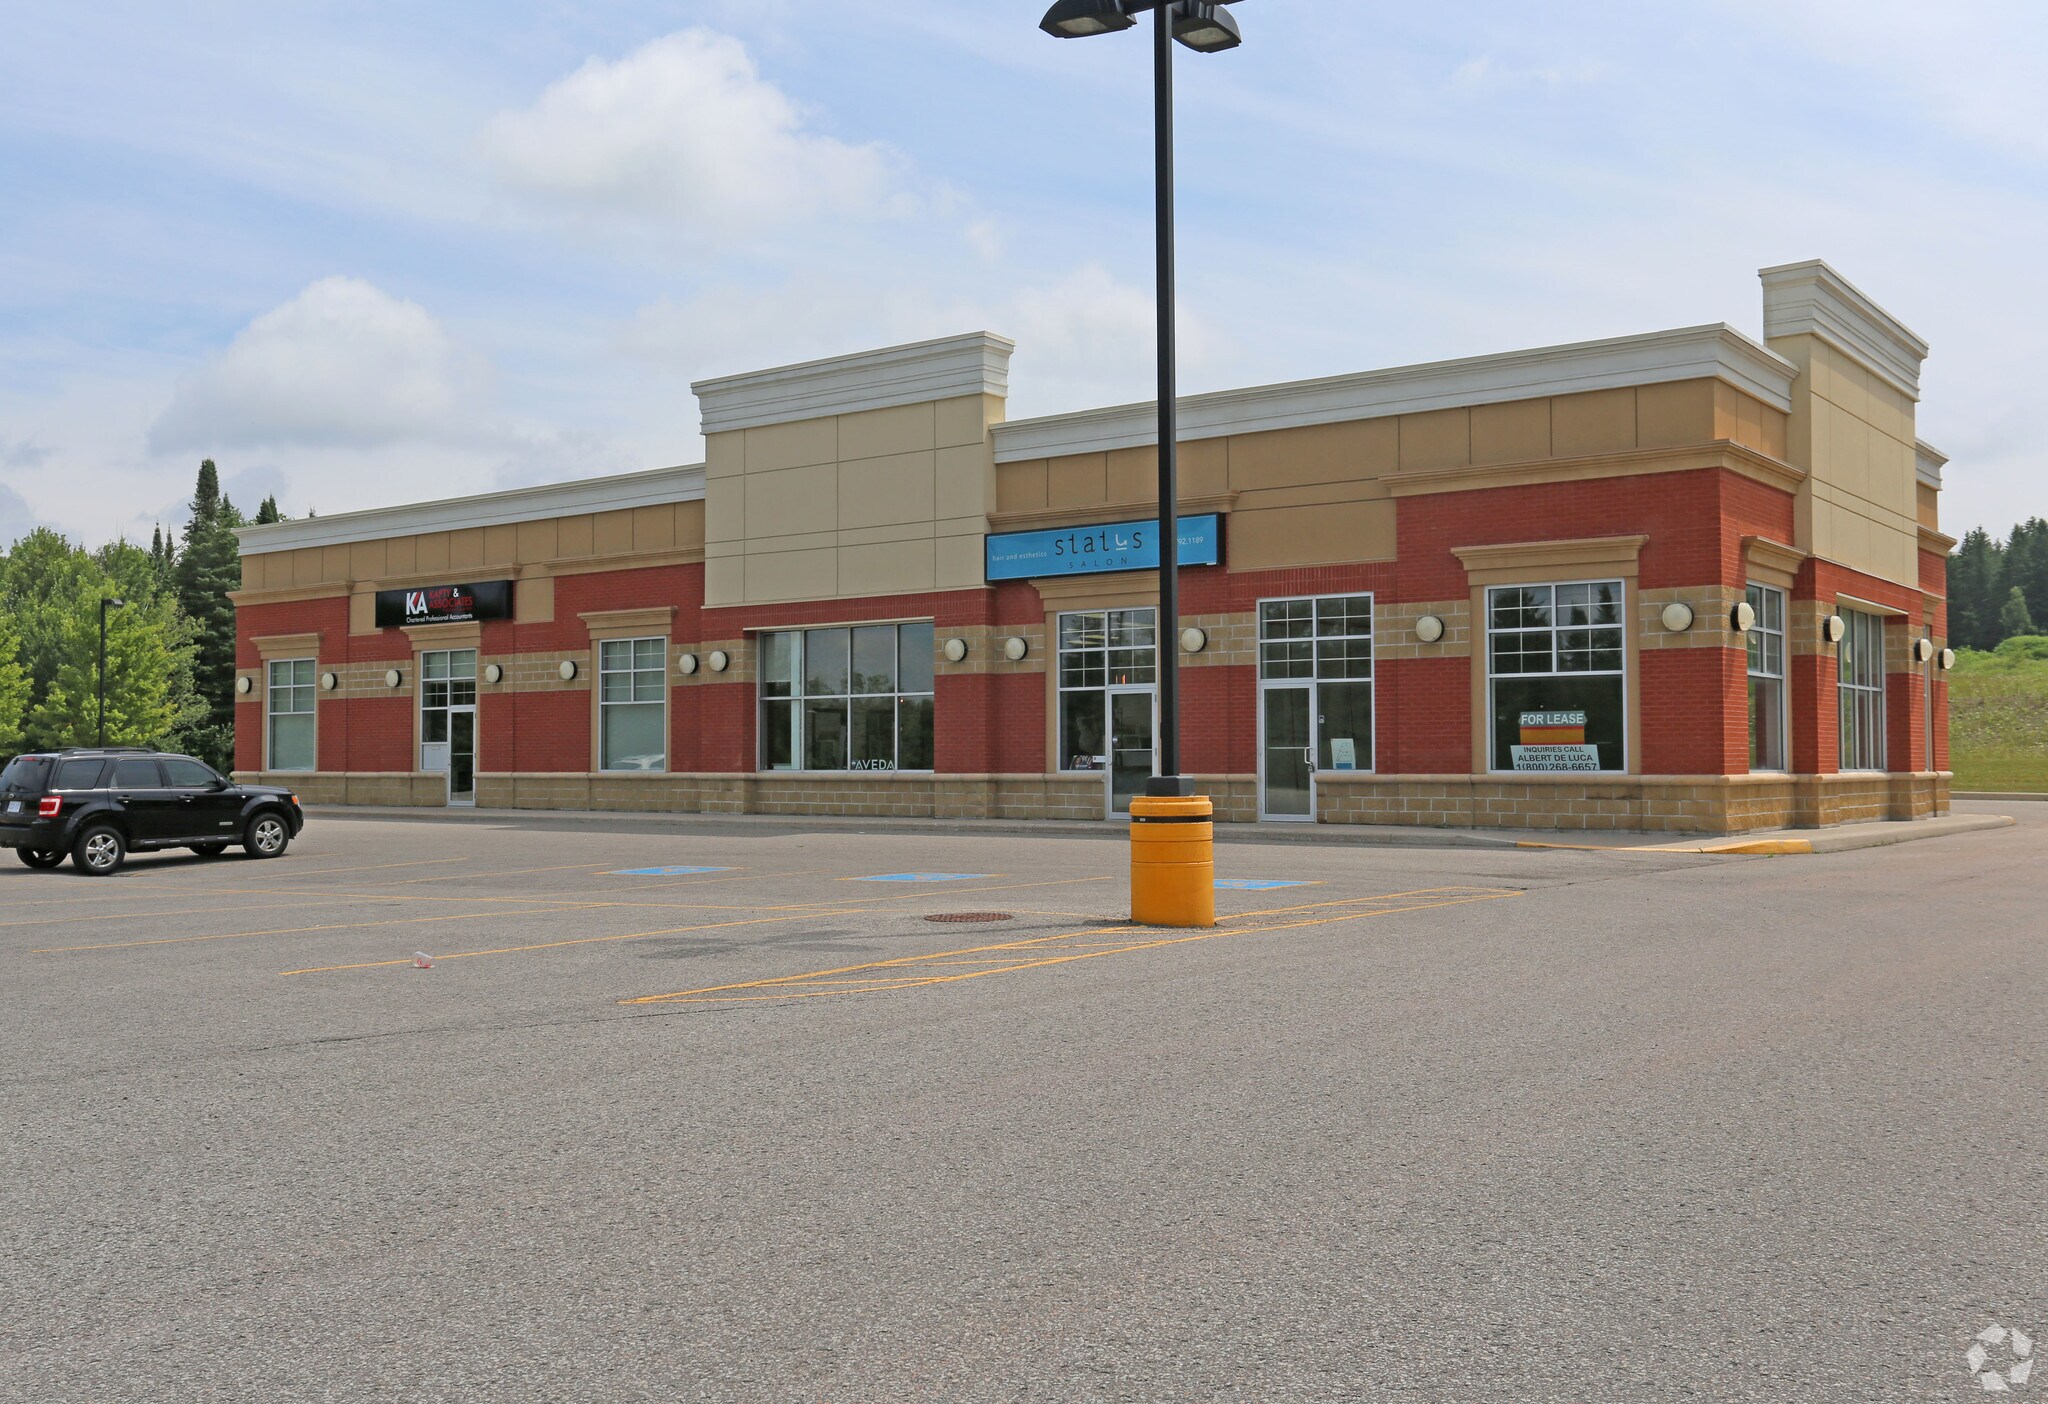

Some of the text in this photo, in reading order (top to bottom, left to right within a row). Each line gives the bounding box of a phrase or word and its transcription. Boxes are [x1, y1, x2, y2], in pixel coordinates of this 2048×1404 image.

[1055, 530, 1142, 556] status
[1177, 536, 1204, 546] 92.1189
[1006, 553, 1018, 561] and
[1019, 551, 1047, 560] esthetics
[1069, 557, 1128, 569] SALON
[453, 588, 459, 597] &
[406, 591, 429, 615] KA
[429, 597, 472, 608] ASSOCIATES
[426, 614, 448, 622] Professional
[1521, 713, 1584, 725] FOR LEASE
[1518, 754, 1593, 762] ALBERT DE LUCA
[855, 759, 895, 770] AVEDA
